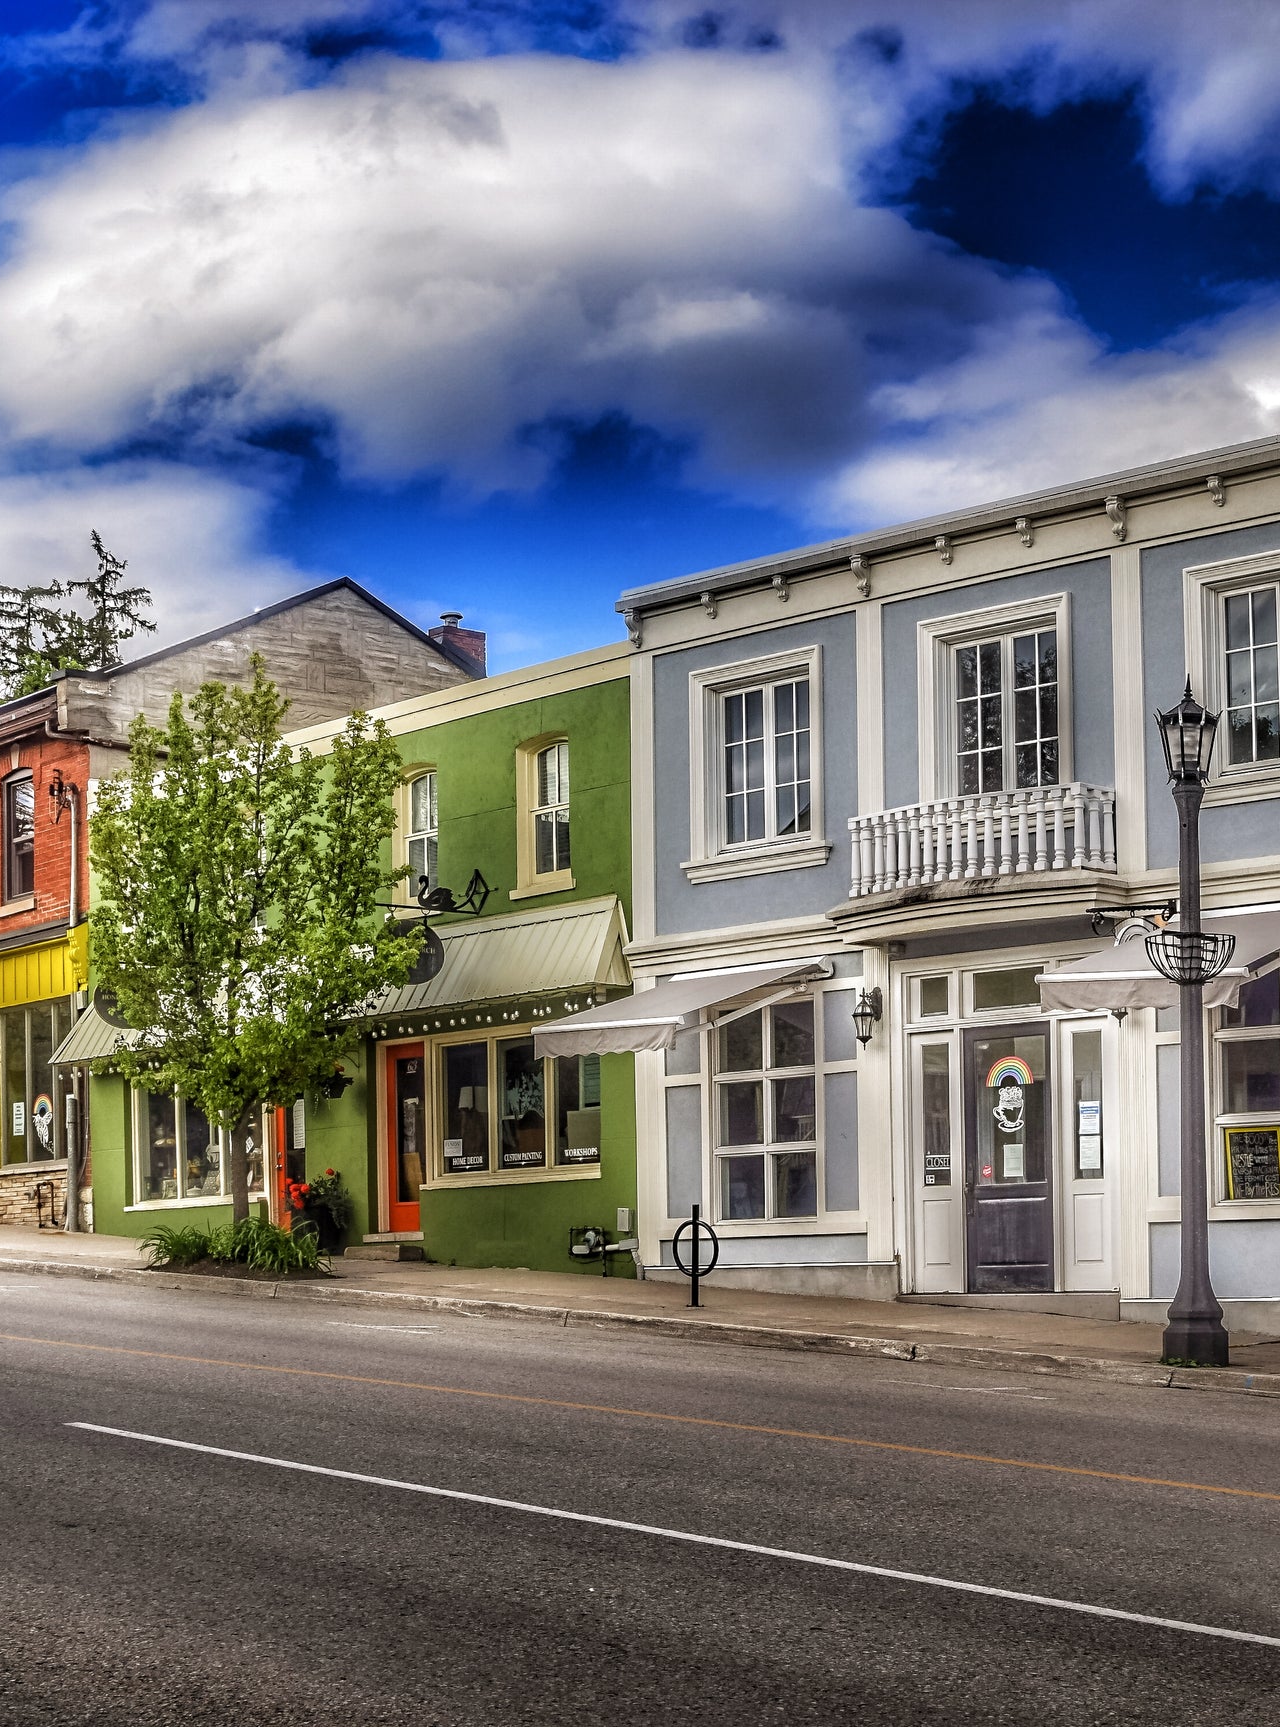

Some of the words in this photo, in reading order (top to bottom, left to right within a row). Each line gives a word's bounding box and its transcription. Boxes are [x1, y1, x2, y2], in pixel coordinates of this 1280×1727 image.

[504, 1152, 521, 1162] CUSTOM
[521, 1151, 542, 1161] PAINTING
[564, 1147, 598, 1157] WORKSHOPS
[452, 1157, 466, 1166] HOME
[467, 1156, 483, 1165] DECOR
